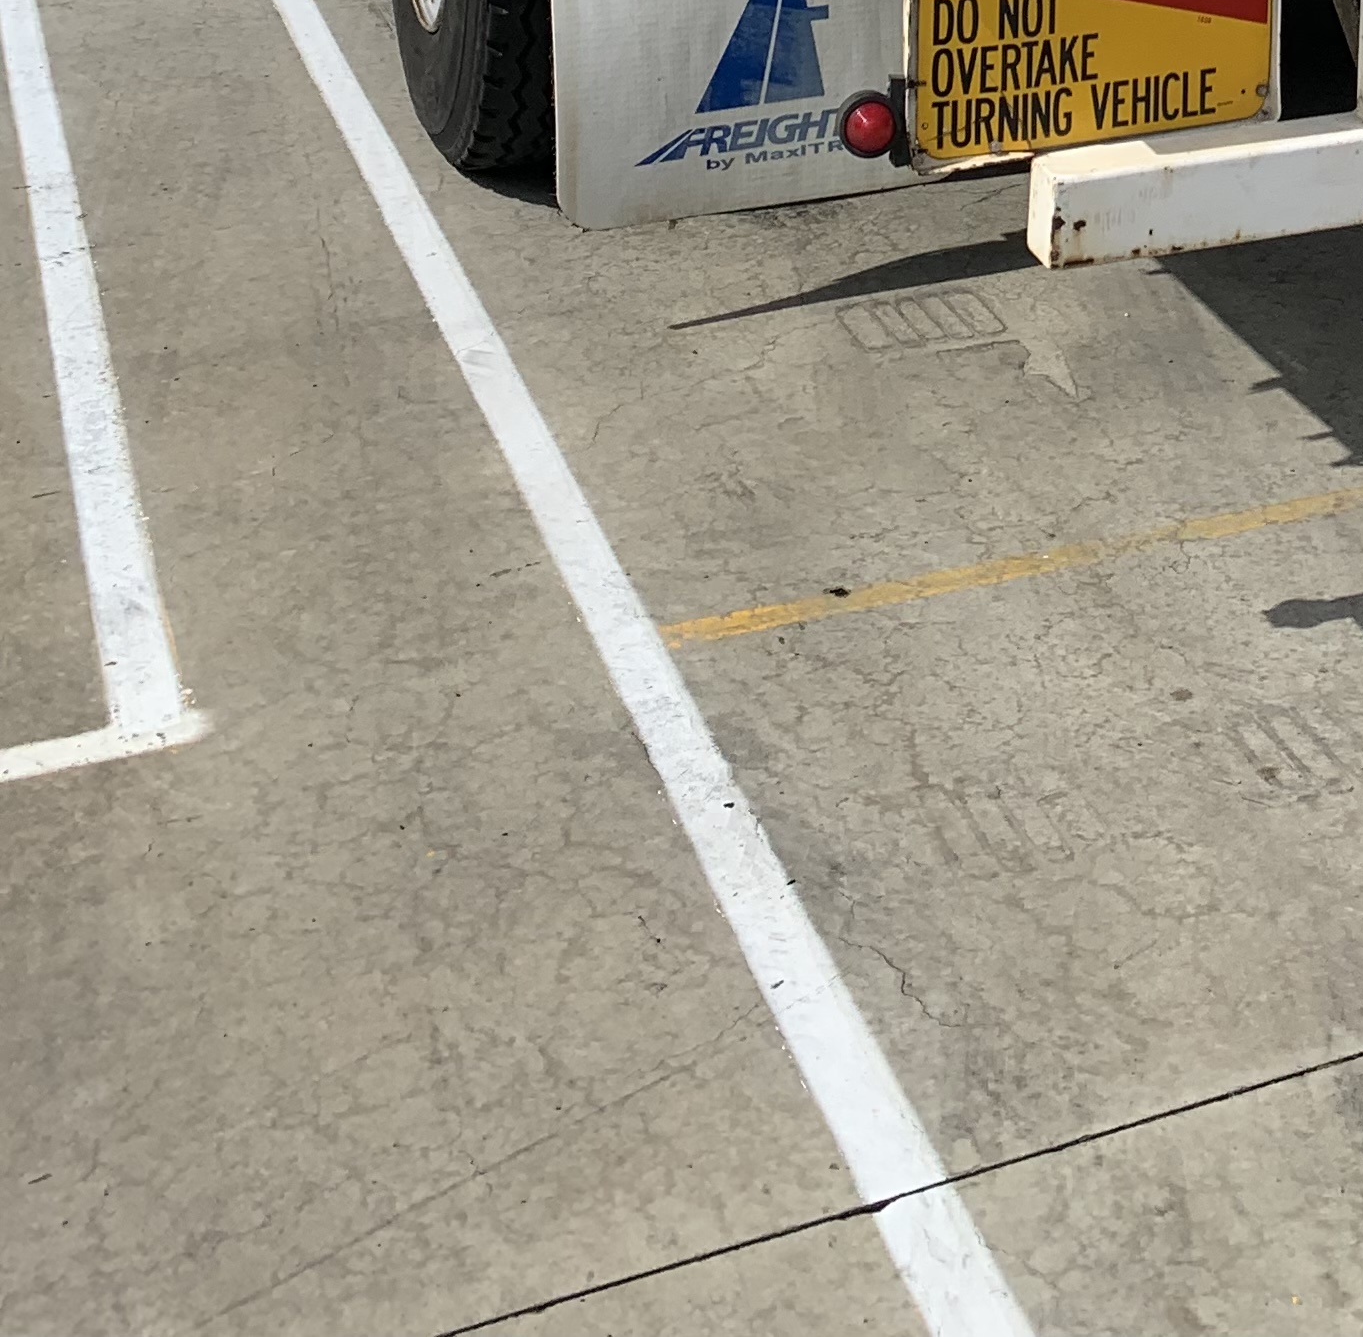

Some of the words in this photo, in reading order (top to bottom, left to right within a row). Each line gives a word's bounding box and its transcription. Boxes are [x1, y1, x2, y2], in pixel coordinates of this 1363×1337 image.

[931, 33, 1099, 97] OVERTAKE
[931, 87, 1073, 150] TURNING
[1091, 67, 1217, 130] VEHICLE
[706, 157, 735, 171] by
